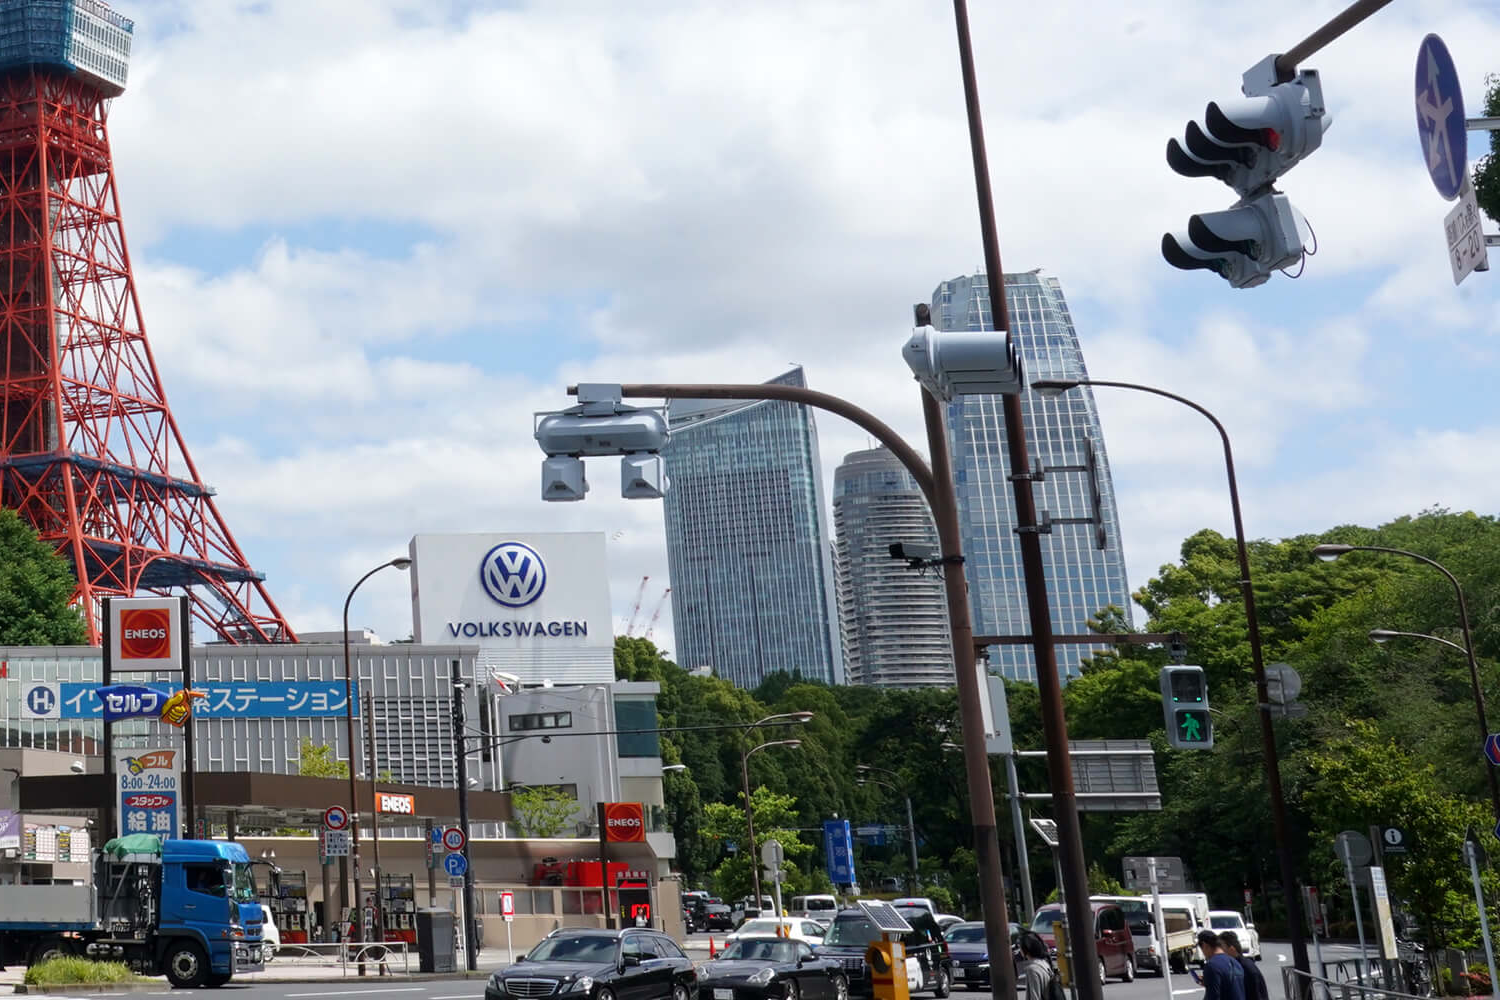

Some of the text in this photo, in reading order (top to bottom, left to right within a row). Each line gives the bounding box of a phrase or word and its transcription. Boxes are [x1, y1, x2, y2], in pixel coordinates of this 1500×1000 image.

[1455, 230, 1480, 271] 8-20
[124, 628, 166, 639] ENEOS
[449, 621, 587, 638] VOLKSWAGEN
[106, 693, 158, 713] セルフ
[146, 755, 168, 767] フル
[131, 796, 169, 806] スタッフが
[381, 795, 411, 813] ENEOS
[127, 811, 171, 832] 給油
[607, 818, 641, 827] ENEOS
[448, 833, 461, 845] 40
